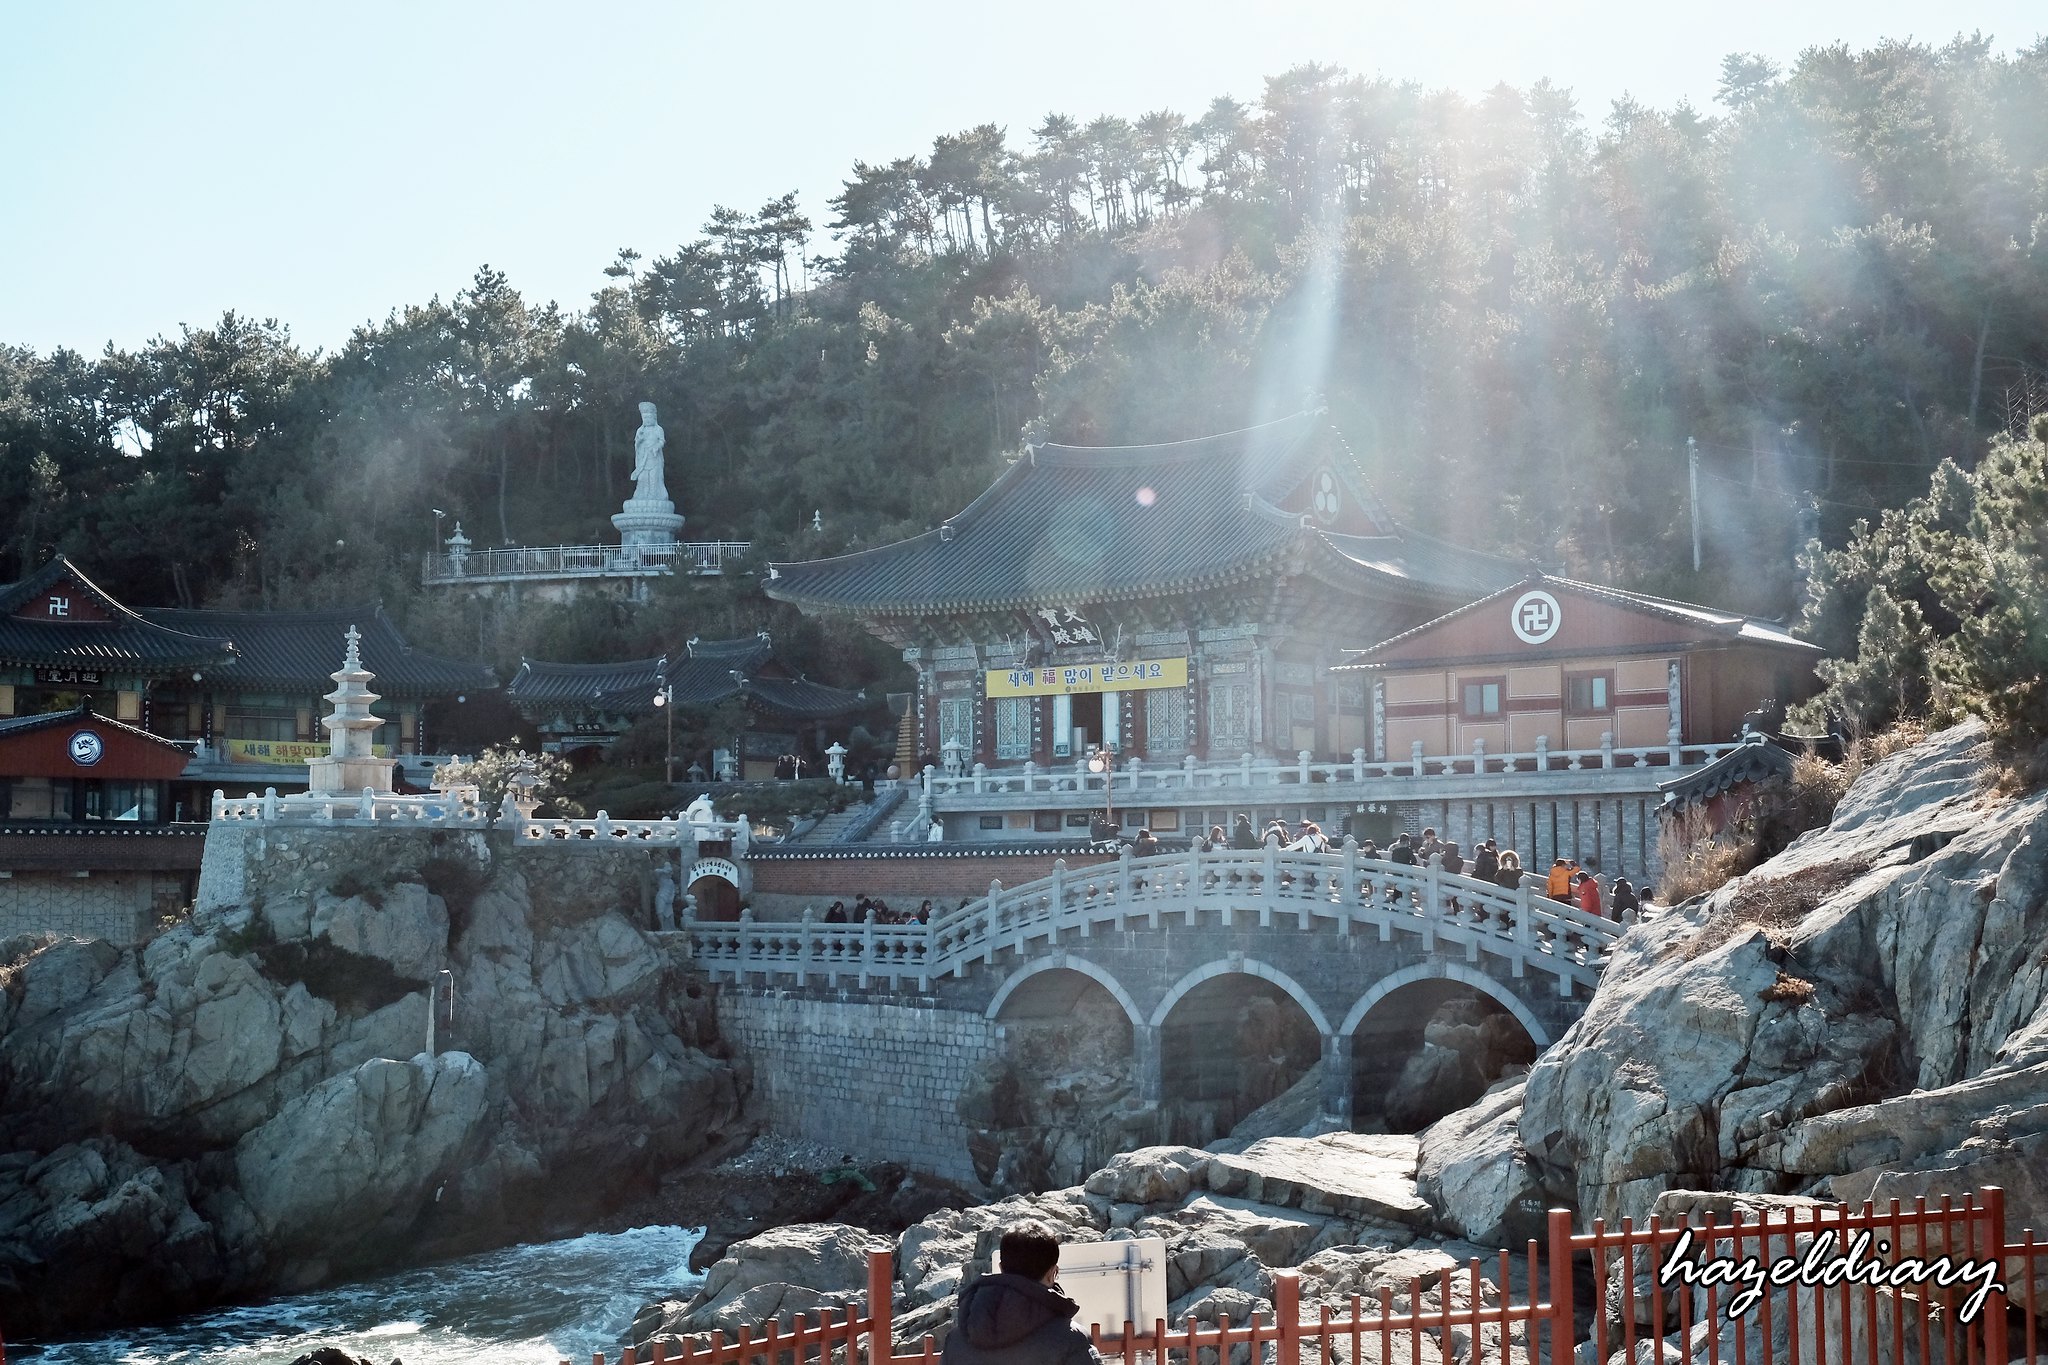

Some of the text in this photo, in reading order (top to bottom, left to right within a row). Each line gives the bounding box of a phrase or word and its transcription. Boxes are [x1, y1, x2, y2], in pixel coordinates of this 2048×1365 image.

[1007, 663, 1163, 687] 새해 福 많이 받으세요
[243, 744, 270, 756] 새해
[276, 745, 316, 758] 해맞이
